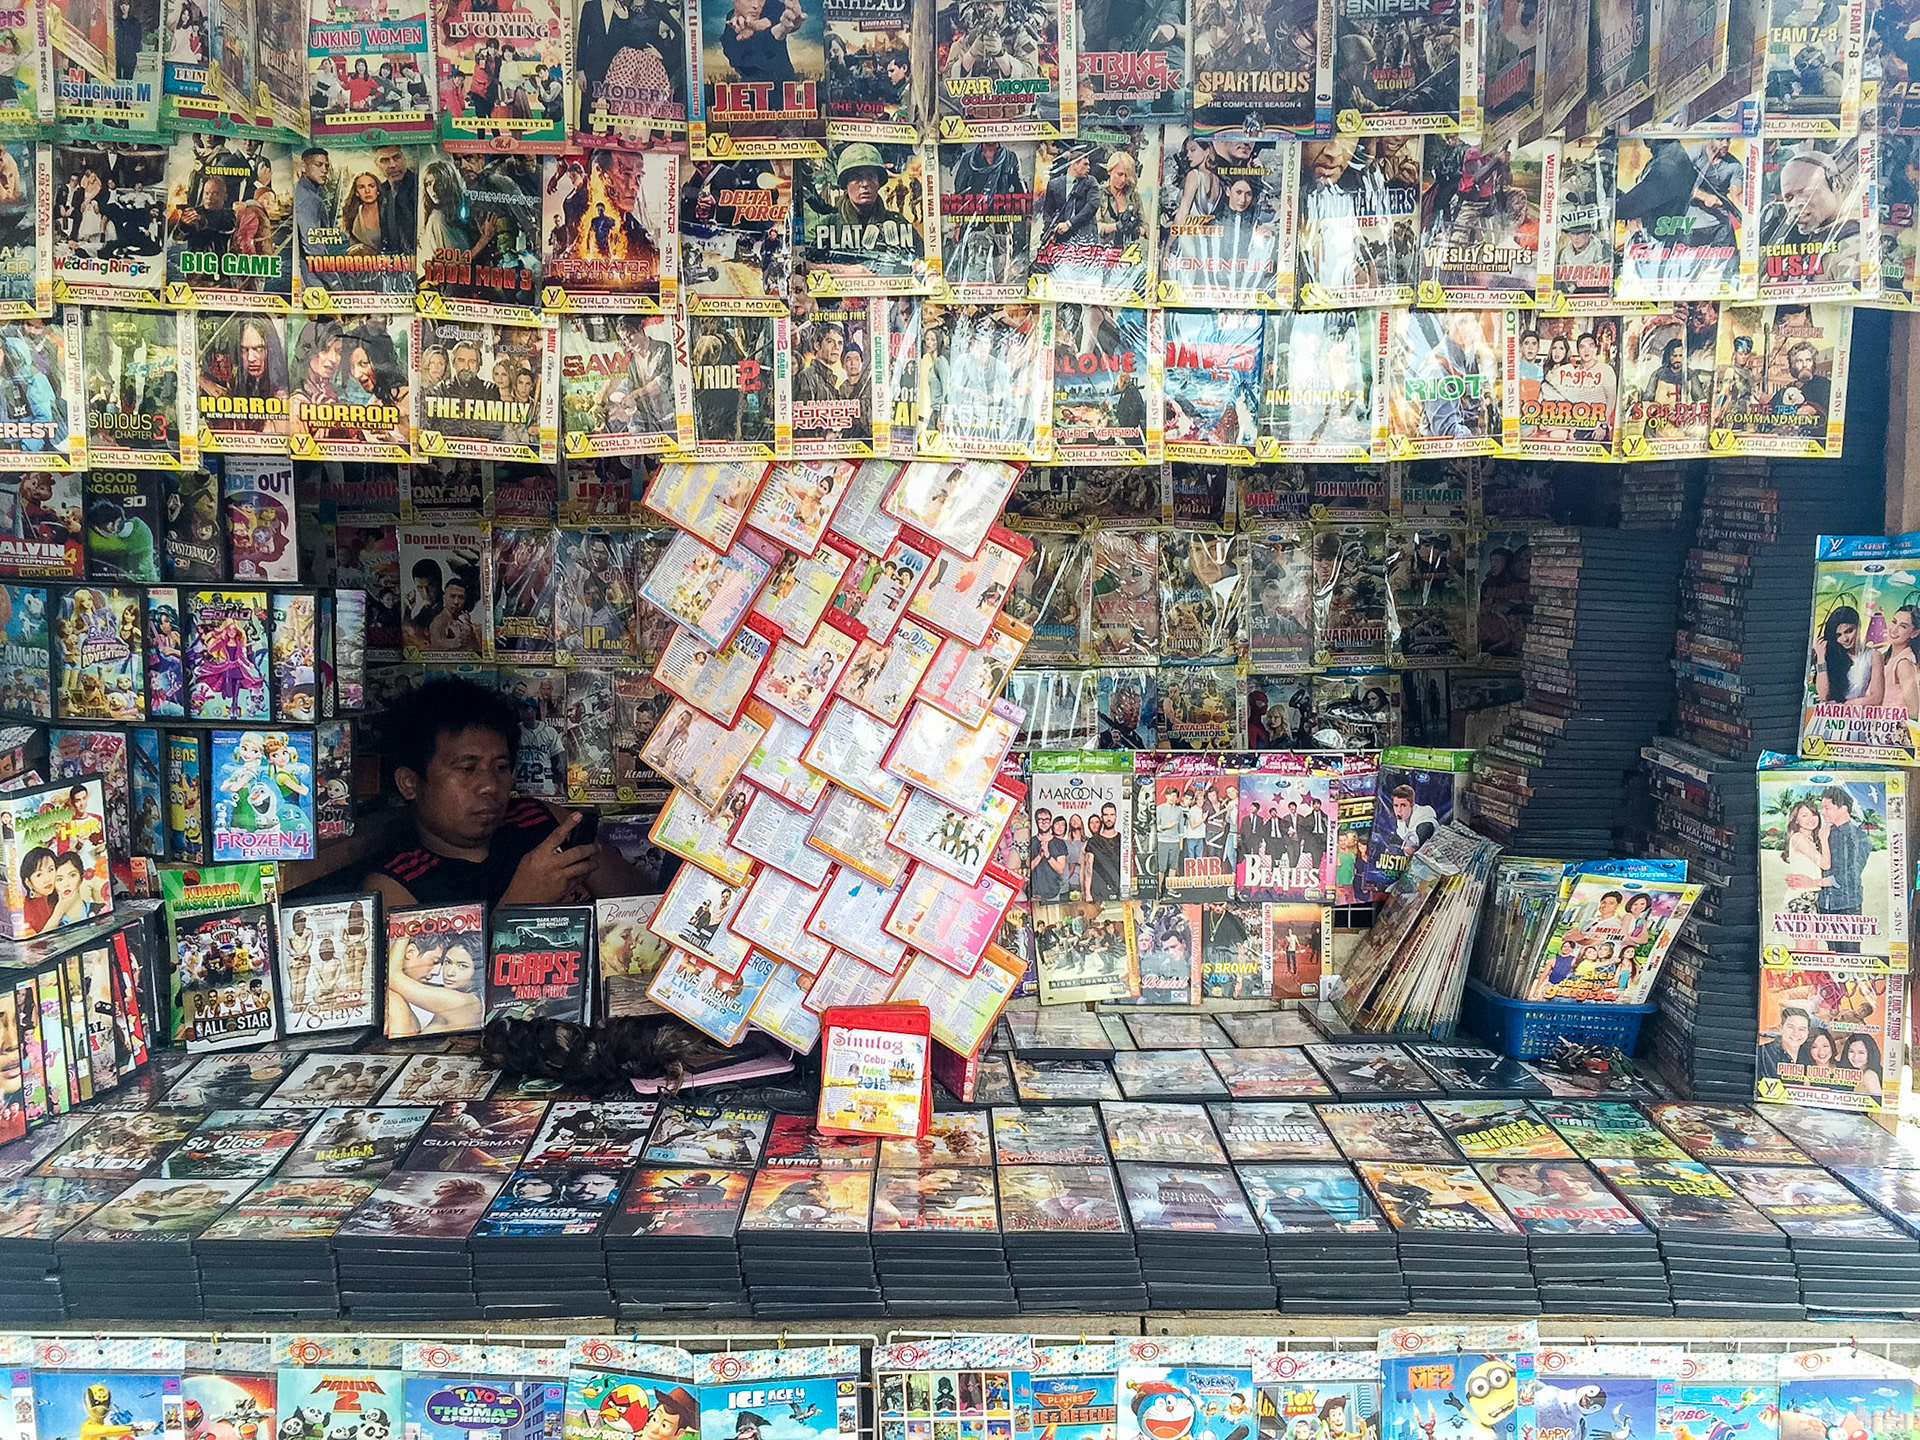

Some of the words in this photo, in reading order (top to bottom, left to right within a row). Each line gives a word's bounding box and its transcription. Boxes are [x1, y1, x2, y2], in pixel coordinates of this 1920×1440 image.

[1347, 0, 1430, 13] SNIPER
[462, 12, 494, 22] THE
[498, 12, 535, 22] FAMILY
[311, 30, 361, 48] UNKIND
[366, 26, 423, 45] WOMEN
[449, 22, 472, 38] IS
[474, 21, 549, 39] COMING
[1770, 27, 1809, 42] TEAM
[1811, 27, 1838, 42] 7-8
[1077, 52, 1168, 74] STRIKE
[945, 79, 992, 95] WAR
[996, 79, 1050, 94] MOVIE
[1105, 74, 1182, 91] BACK
[1199, 71, 1310, 94] SPARTACUS
[1375, 79, 1411, 91] GLORY
[176, 99, 218, 110] PERFECT
[713, 83, 773, 112] JET
[783, 82, 817, 110] LI
[962, 94, 1035, 107] COLLECTION
[103, 110, 145, 119] SUBTITLE
[611, 100, 686, 119] FARMER
[455, 119, 499, 128] PERFECT
[506, 120, 552, 129] SUBTITLE
[1365, 117, 1410, 127] WORLD
[1412, 116, 1449, 126] MOVIE
[1791, 120, 1829, 129] MOVIE
[205, 166, 251, 177] SURVIVOR
[667, 157, 676, 235] TERMINATOR
[720, 190, 772, 206] DELTA
[733, 204, 791, 227] FORCE
[307, 227, 340, 236] AFTER
[1654, 216, 1697, 236] SPY
[307, 235, 342, 245] EARTH
[816, 221, 914, 251] PLATOON
[436, 248, 472, 263] 2014
[53, 257, 108, 276] Wedding
[109, 257, 151, 276] Ringer
[180, 254, 219, 275] BIG
[222, 254, 282, 276] GAME
[551, 259, 650, 274] TERMINATOR
[1163, 258, 1274, 273] MOMENTUM
[1441, 263, 1465, 272] MOVIE
[1466, 263, 1510, 273] COLLECTION
[1556, 264, 1602, 281] WAR
[424, 260, 470, 284] IRON
[475, 265, 515, 289] MAN
[519, 267, 532, 291] 3
[1444, 291, 1487, 301] WORLD
[1489, 291, 1526, 301] MOVIE
[700, 300, 741, 310] WORLD
[743, 300, 778, 310] MOVIE
[809, 312, 848, 322] CATCHING
[849, 311, 867, 321] FIRE
[1164, 342, 1256, 371] JAWS
[561, 354, 633, 377] SAW
[1404, 374, 1487, 402] RIOT
[302, 404, 398, 424] HORROR
[425, 397, 465, 421] THE
[469, 399, 531, 424] FAMILY
[1749, 404, 1774, 415] THE
[1776, 404, 1798, 414] TEN
[1725, 414, 1820, 427] COMMANDMENT
[114, 430, 153, 440] CHAPTER
[1737, 439, 1776, 450] WORLD
[1779, 440, 1814, 450] MOVIE
[1056, 448, 1098, 459] WORLD
[1101, 448, 1136, 458] MOVIE
[92, 473, 138, 484] GOOD
[257, 472, 292, 491] OUT
[449, 485, 481, 498] JAA
[1315, 483, 1346, 497] JOHN
[1349, 483, 1383, 497] WICK
[122, 496, 147, 509] 3D
[404, 534, 449, 545] Donnie
[453, 534, 476, 545] Yen
[0, 540, 66, 560] ALVIN
[63, 541, 78, 564] 4
[22, 568, 48, 577] ROAD
[48, 567, 72, 577] CHIP
[200, 609, 253, 621] SQUAD
[583, 627, 605, 649] IP
[603, 640, 623, 650] MAN
[1320, 628, 1347, 642] WAR
[1347, 628, 1386, 640] MOVIE
[1814, 704, 1861, 720] MARIAN
[1862, 706, 1909, 721] RIVERA
[1172, 722, 1221, 732] CAVALIERS
[1342, 723, 1379, 736] NIKITA
[1824, 719, 1846, 731] AND
[1849, 720, 1871, 732] LOVI
[1872, 720, 1895, 733] POE
[625, 769, 652, 779] KEANU
[1039, 786, 1104, 801] MAROON
[1104, 786, 1114, 801] 5
[217, 832, 292, 850] FROZEN
[292, 833, 310, 854] 4
[242, 847, 281, 858] FEVER
[1185, 857, 1222, 877] RNB
[1244, 852, 1320, 892] BEATLES
[183, 882, 240, 899] KUROKO
[172, 893, 256, 912] BASKETBALL
[1774, 913, 1818, 923] KATHRYN
[1819, 915, 1878, 924] BERNARDO
[388, 913, 481, 940] RIGODON
[1595, 927, 1622, 935] MAYBE
[1771, 920, 1808, 934] AND
[1814, 921, 1882, 937] DANIEL
[1605, 934, 1625, 943] TIME
[493, 951, 581, 988] CORPSE
[1214, 963, 1259, 975] BROWN
[1209, 975, 1229, 984] AYO
[514, 985, 542, 1000] ANNA
[203, 1021, 227, 1037] ALL
[237, 1012, 269, 1029] STAR
[832, 1033, 904, 1055] Sinulog
[863, 1054, 887, 1065] Cebu
[1419, 1045, 1498, 1059] CREED
[1777, 1063, 1805, 1076] PINOY
[1807, 1064, 1832, 1079] LOVE
[1834, 1068, 1863, 1082] STORY
[857, 1075, 887, 1091] 2016
[1782, 1074, 1808, 1082] MOVIE
[1809, 1077, 1858, 1087] COLLECTION
[858, 1099, 887, 1109] Sinulog
[1228, 1125, 1318, 1135] BROTHERS
[1457, 1120, 1532, 1146] SHOOTER
[1486, 1125, 1553, 1150] HUNTER
[185, 1136, 211, 1151] So
[213, 1134, 267, 1151] Close
[422, 1138, 527, 1149] GUARDSMAN
[1224, 1134, 1328, 1142] ENEMIES
[489, 1211, 603, 1220] FRANKENSTEIN
[1518, 1206, 1633, 1227] EXPOSED
[1409, 1364, 1454, 1375] DESPICABLE
[313, 1379, 386, 1395] PANDA
[1409, 1371, 1455, 1391] ME2
[333, 1392, 363, 1414] 2
[455, 1388, 496, 1404] TAYO
[728, 1390, 766, 1410] ICE
[768, 1389, 796, 1405] AGE
[796, 1387, 806, 1401] 4
[1047, 1394, 1084, 1406] PLANES
[1286, 1389, 1317, 1407] TOY
[430, 1405, 519, 1420] THOMAS
[1061, 1408, 1115, 1422] RESCUE
[1285, 1405, 1316, 1414] STORY
